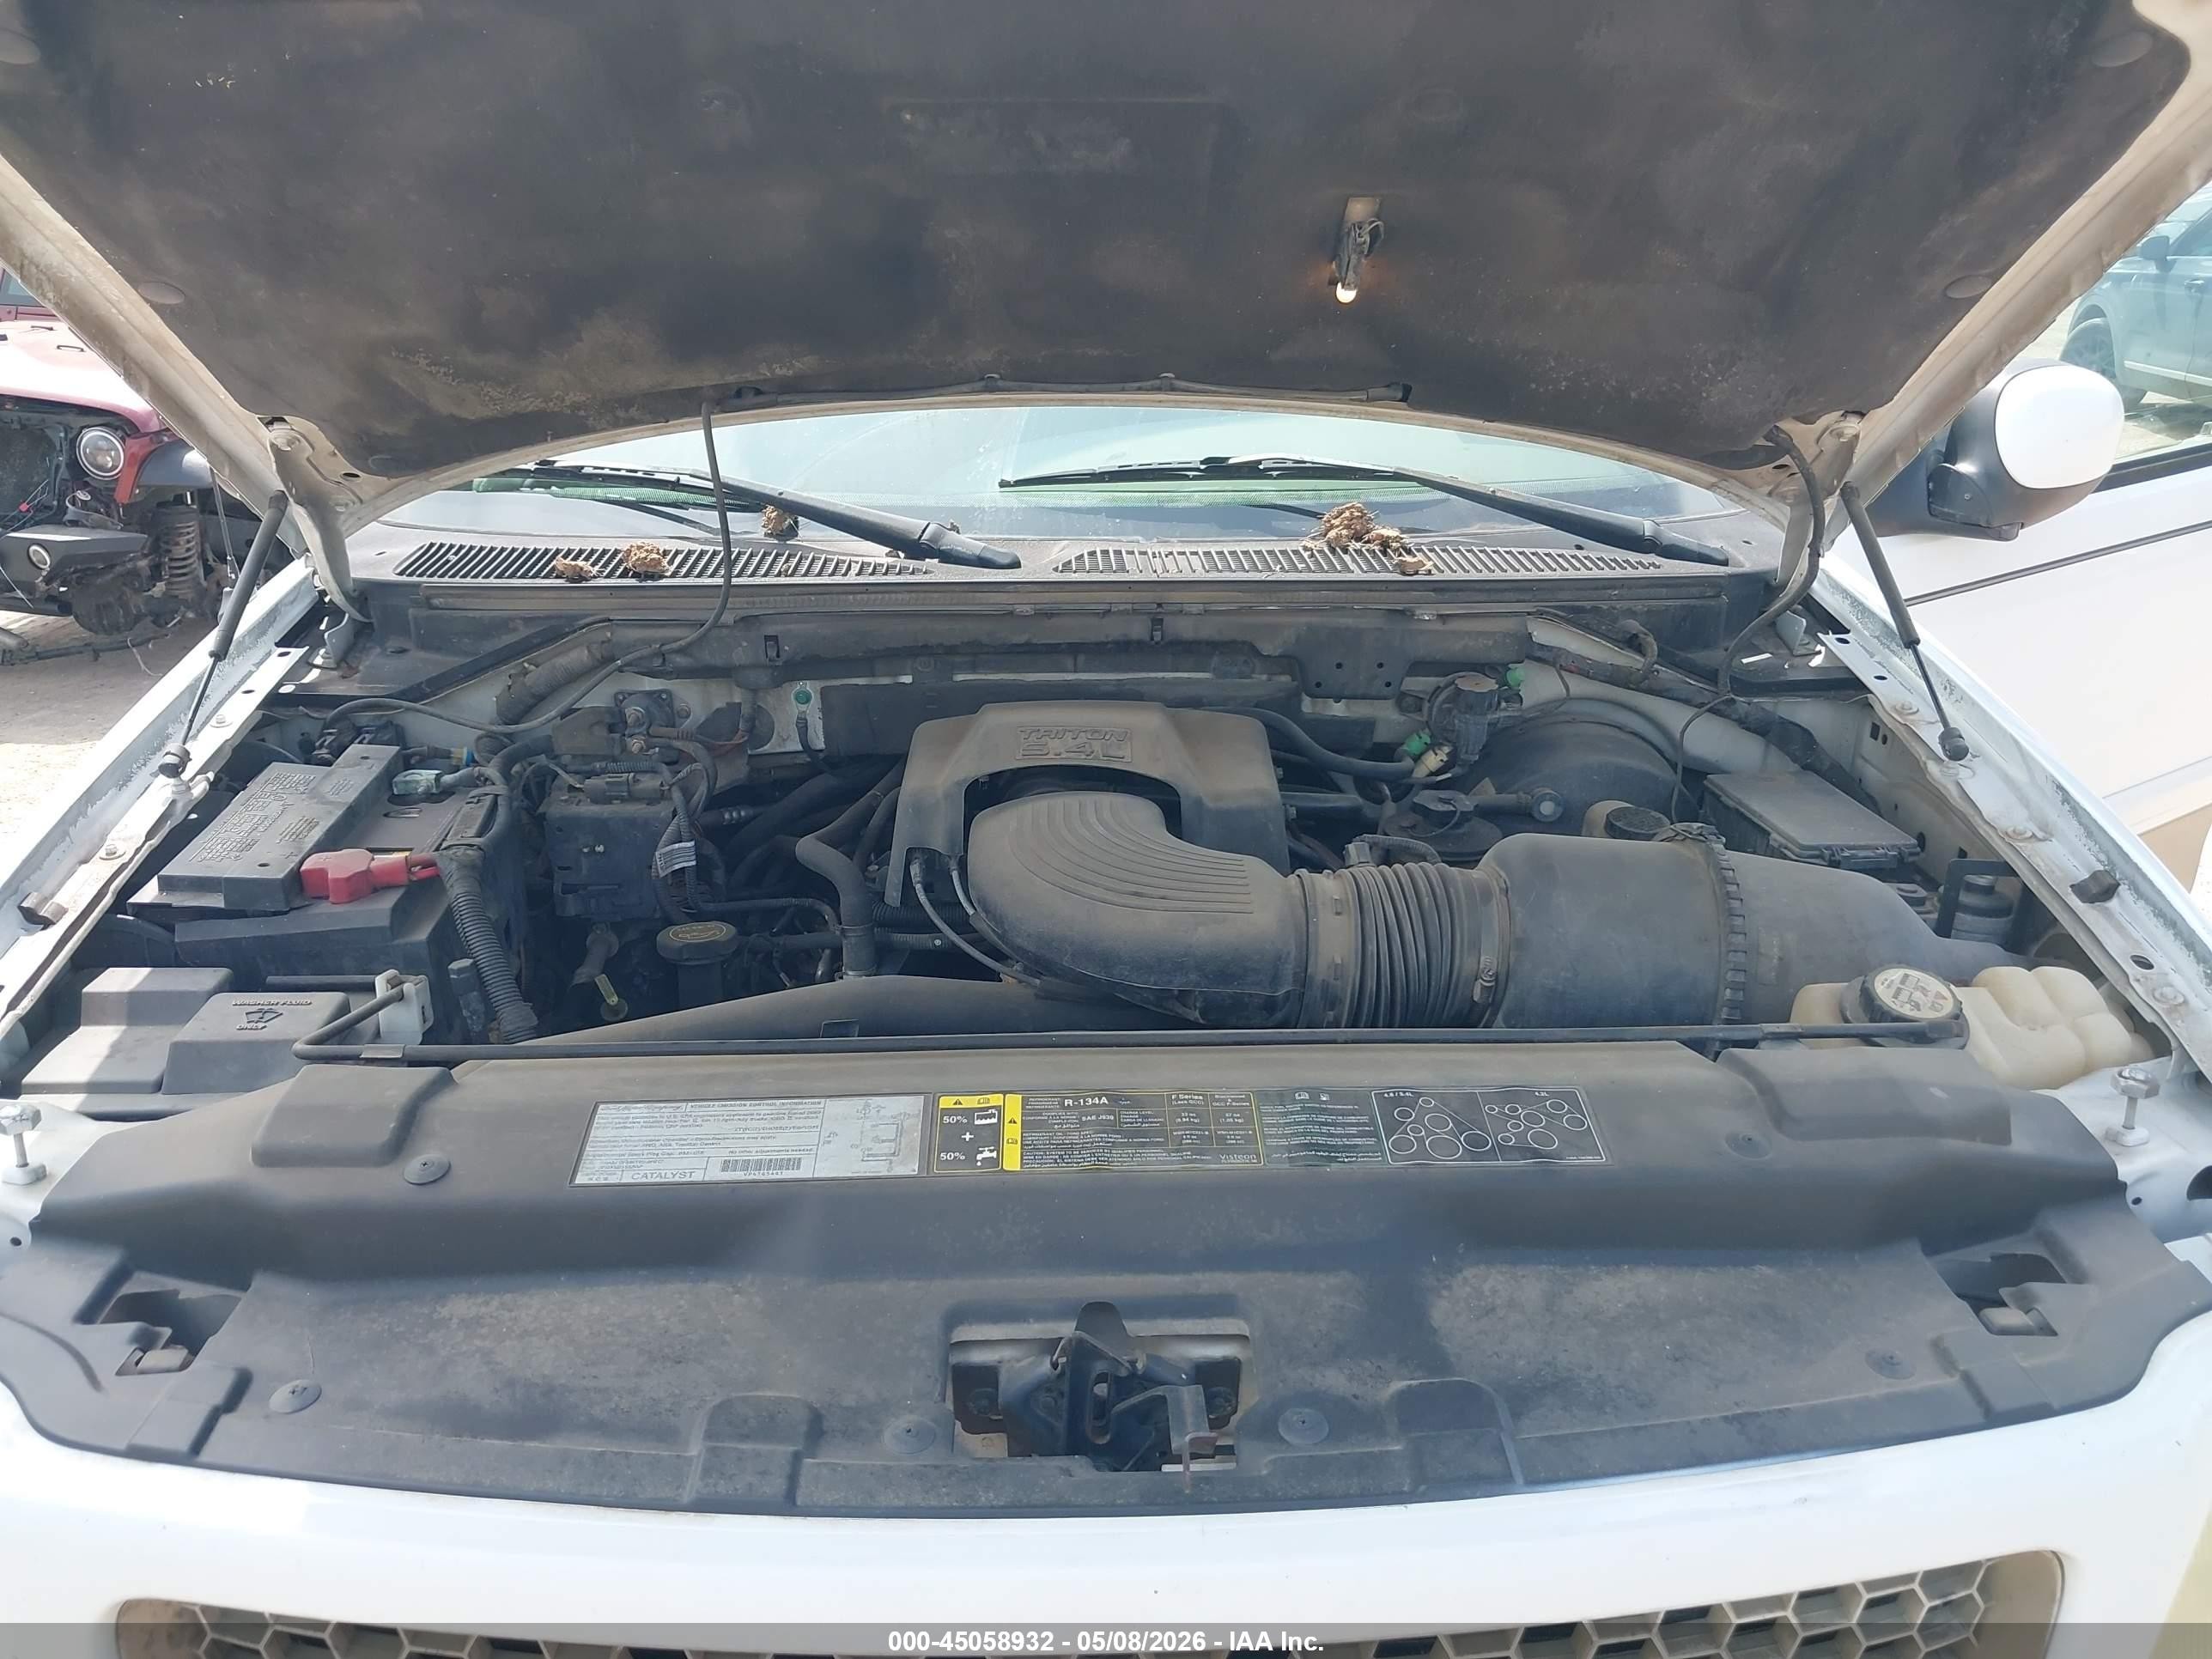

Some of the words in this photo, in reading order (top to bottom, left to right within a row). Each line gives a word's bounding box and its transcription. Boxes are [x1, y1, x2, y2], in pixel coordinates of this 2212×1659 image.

[1016, 727, 1128, 742] TRITON
[1020, 741, 1126, 761] 5.4L
[1064, 1097, 1109, 1107] R-134A
[631, 1170, 696, 1180] CATALYST
